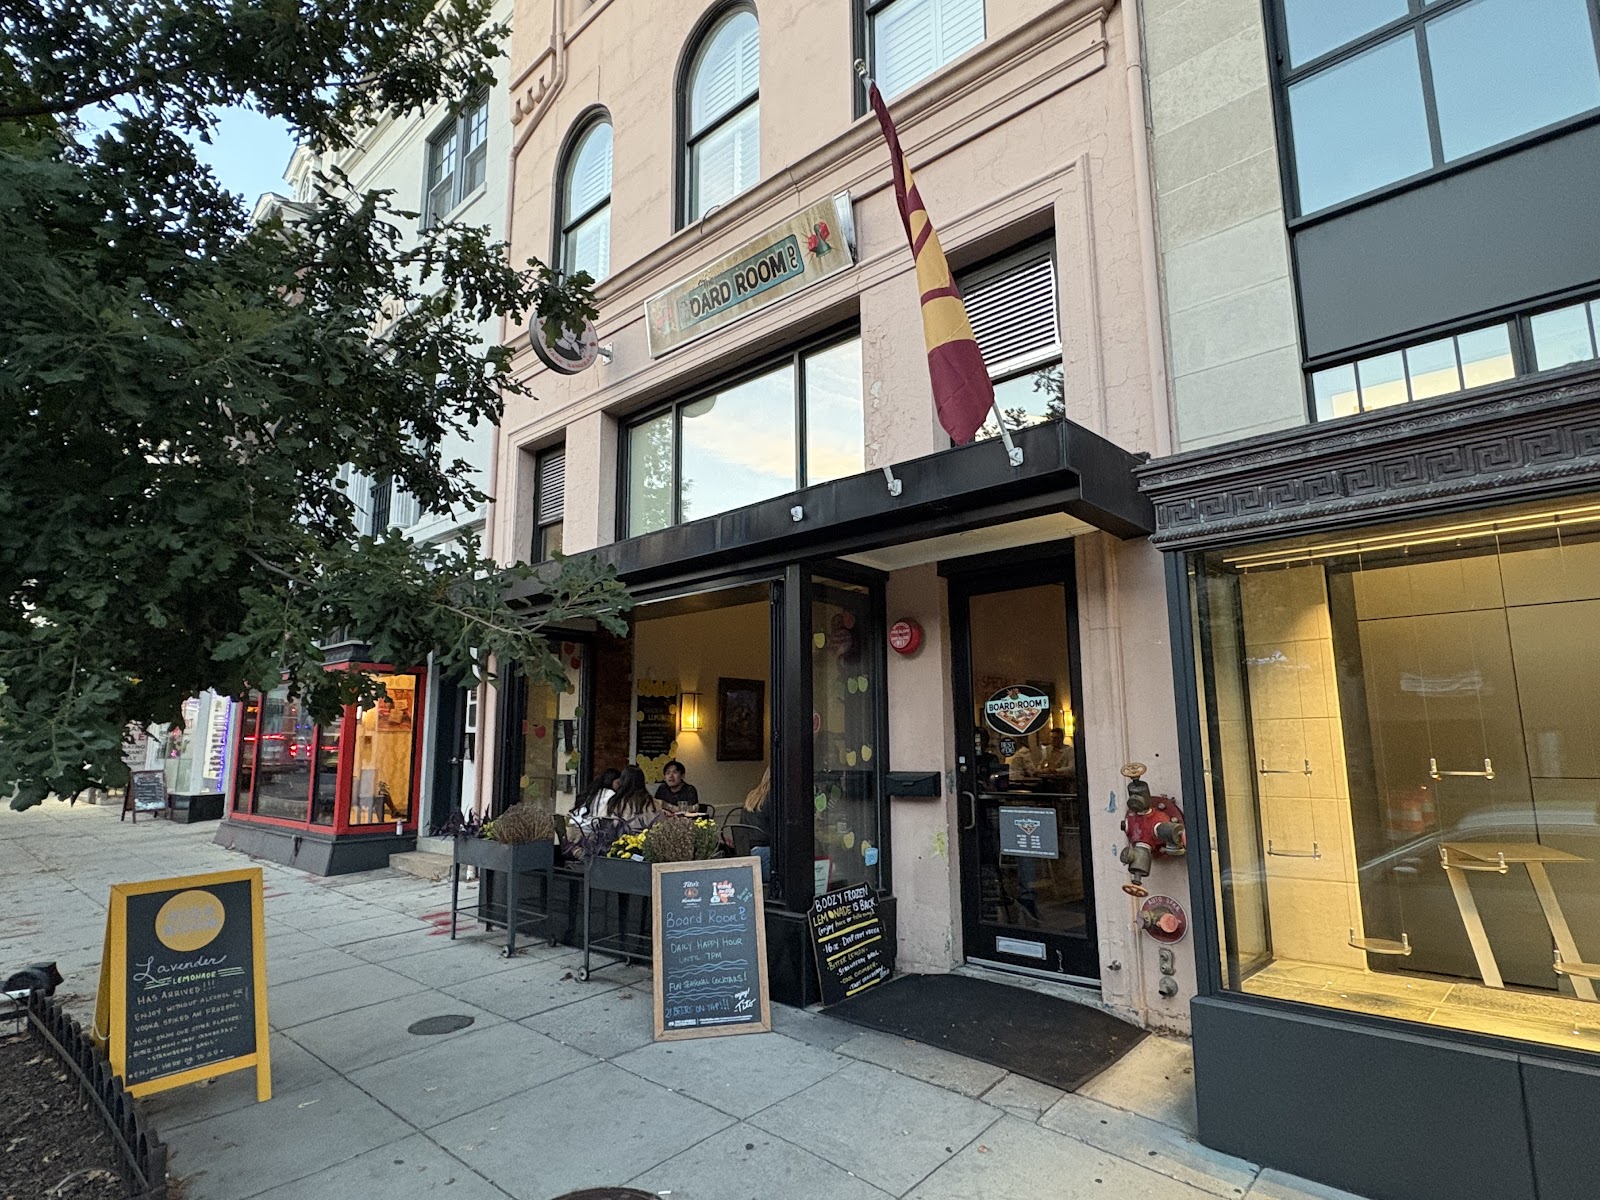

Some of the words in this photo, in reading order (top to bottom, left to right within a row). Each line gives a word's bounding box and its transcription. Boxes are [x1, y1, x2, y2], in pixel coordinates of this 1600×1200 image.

[680, 282, 731, 320] OARD
[734, 254, 788, 296] ROOM
[988, 701, 1015, 712] BOARD
[1017, 699, 1043, 709] ROOM
[683, 880, 700, 889] Tito's
[815, 893, 842, 912] BOOZY
[844, 884, 868, 901] FROZEN
[1148, 897, 1163, 906] AUTO
[666, 910, 702, 928] Board
[813, 905, 852, 927] LEMONADE
[852, 902, 859, 912] IS
[670, 941, 692, 954] DAILY
[697, 938, 720, 950] HAPPY
[722, 937, 744, 947] HOUR
[705, 952, 722, 960] 7PM
[133, 955, 227, 983] Lavender
[172, 971, 217, 985] LEMONADE
[669, 982, 682, 992] FUN
[134, 1008, 161, 1021] ENJOY
[166, 999, 197, 1012] WITHOUT
[200, 992, 230, 1004] ALCOHOL
[136, 994, 158, 1005] HAS
[695, 1004, 705, 1014] ON
[135, 1021, 159, 1033] VODKA
[163, 1014, 189, 1026] SPIKED
[133, 1038, 152, 1048] ALSO
[156, 1032, 174, 1042] ENJOY
[176, 1028, 189, 1036] OUR
[133, 1066, 158, 1078] ENJOY
[162, 1059, 181, 1070] HERE
